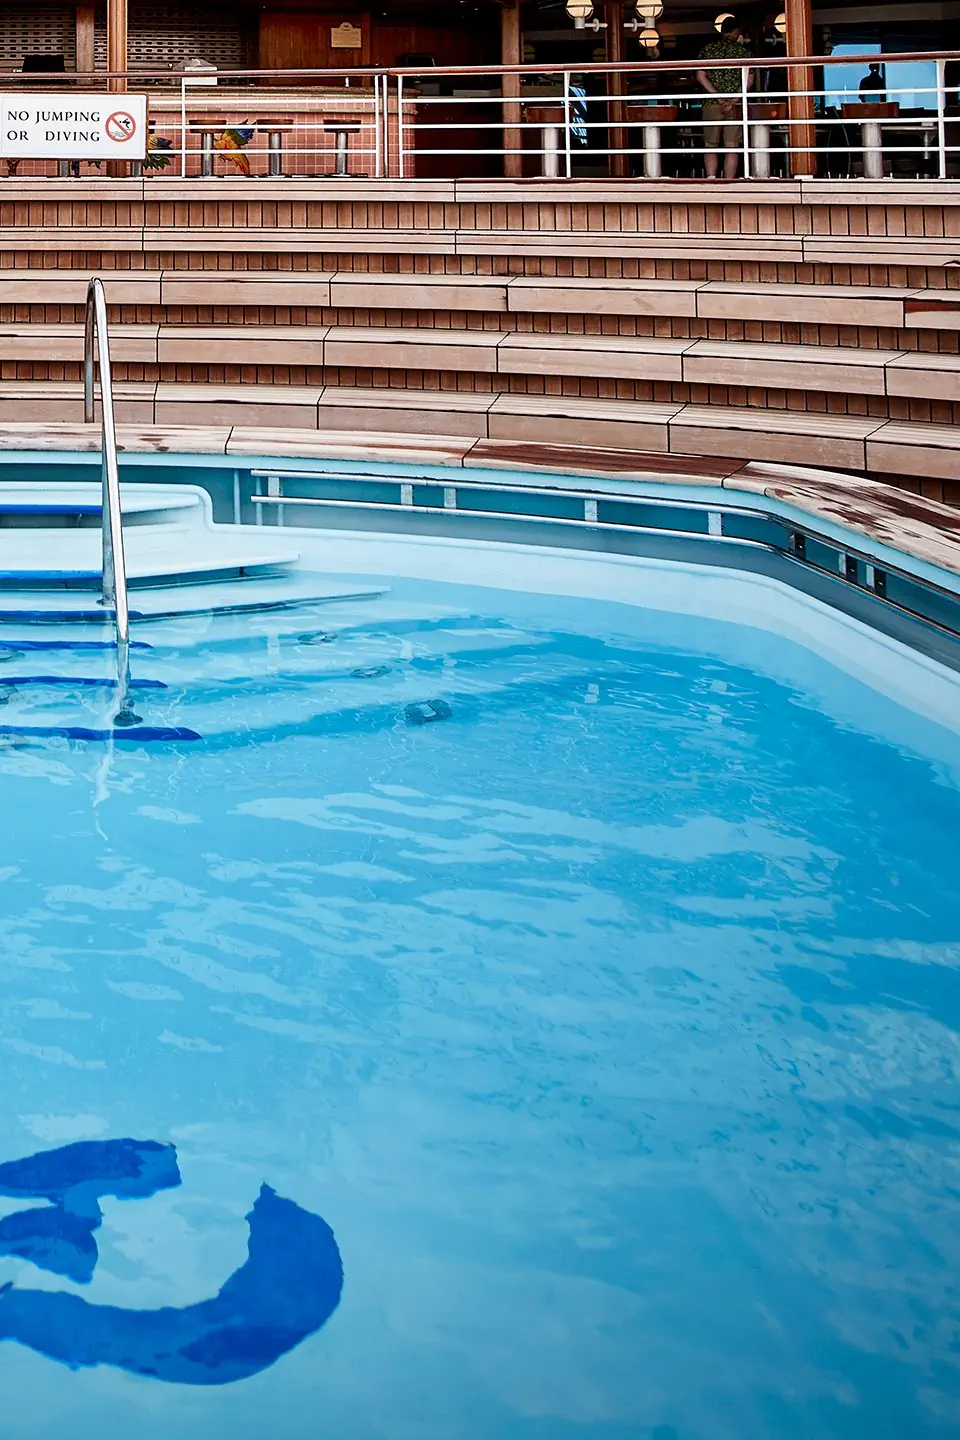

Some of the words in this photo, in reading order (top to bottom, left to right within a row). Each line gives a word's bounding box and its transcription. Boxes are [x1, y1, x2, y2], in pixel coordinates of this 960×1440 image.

[7, 110, 30, 122] NO
[35, 110, 101, 124] JUMPING
[6, 129, 30, 142] OR
[45, 130, 100, 142] DIVING
